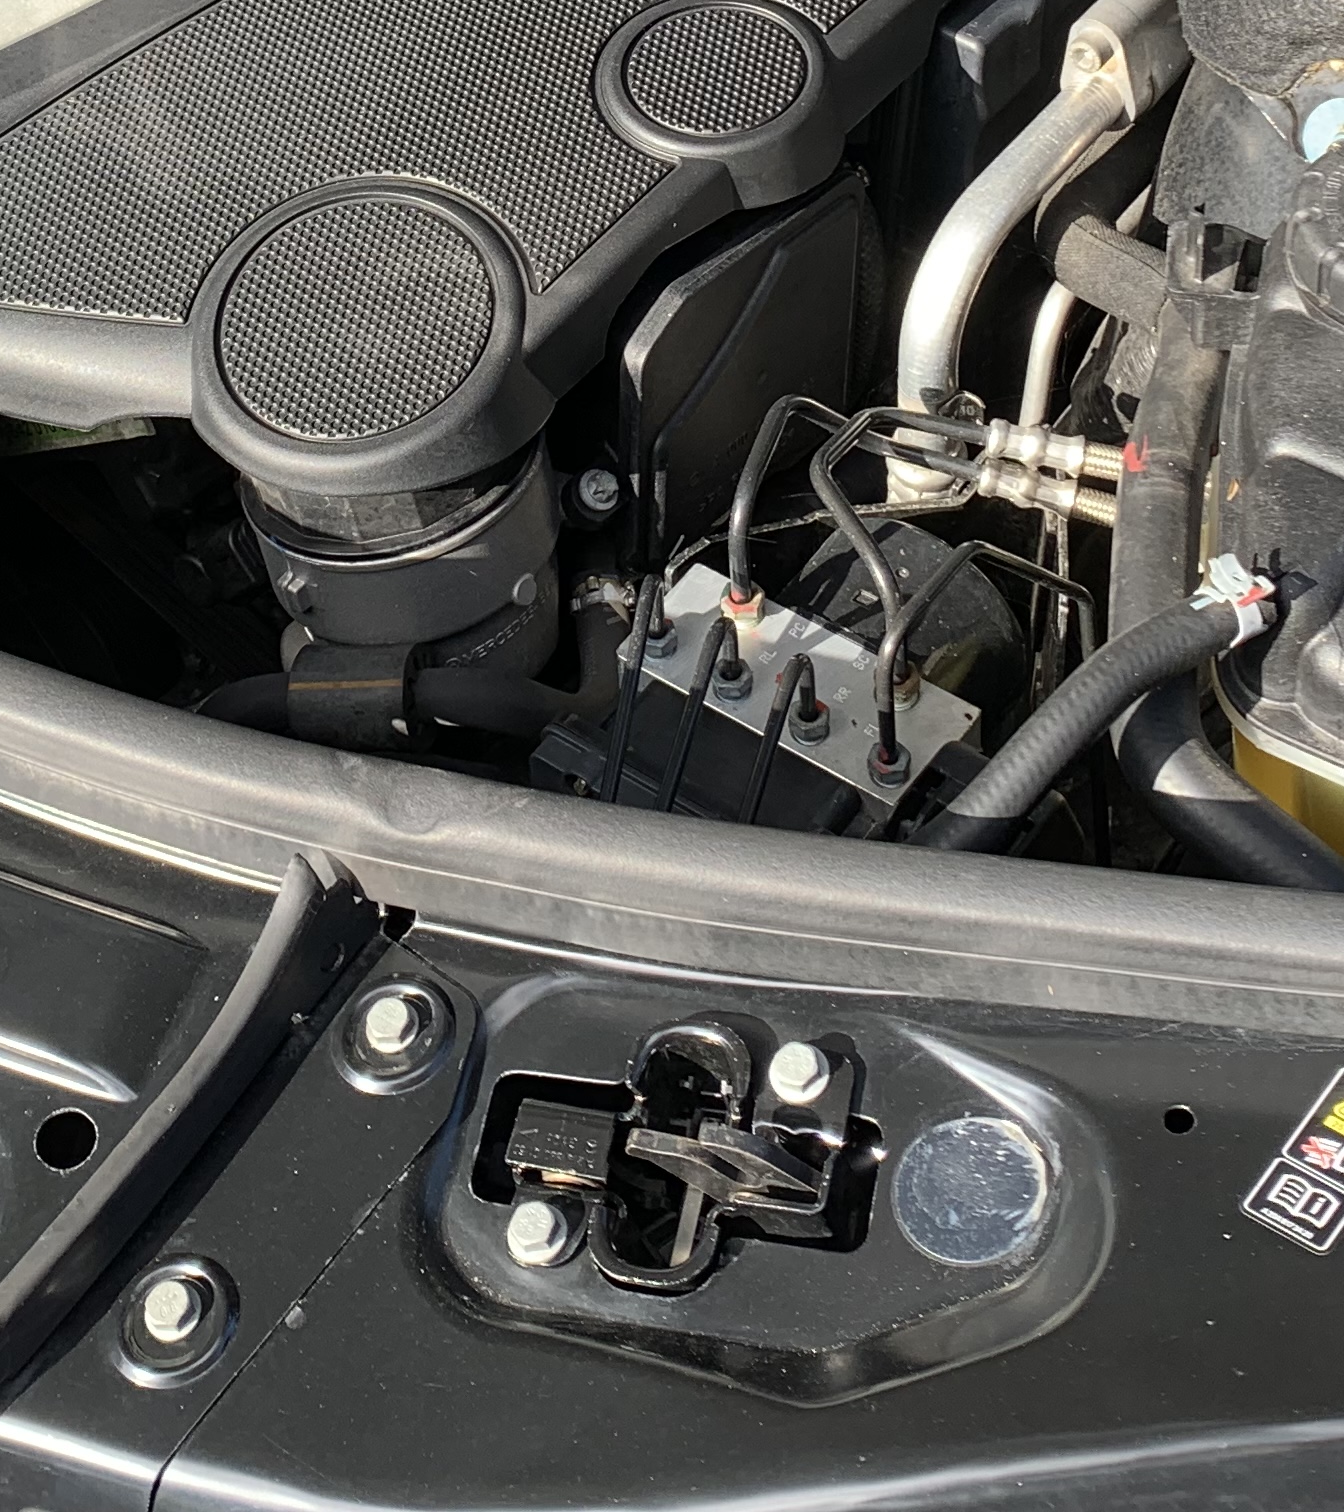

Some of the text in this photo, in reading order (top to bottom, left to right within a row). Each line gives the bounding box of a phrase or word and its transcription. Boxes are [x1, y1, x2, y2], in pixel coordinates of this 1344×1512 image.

[788, 622, 806, 638] PC
[758, 649, 778, 665] RL
[832, 686, 853, 704] RR
